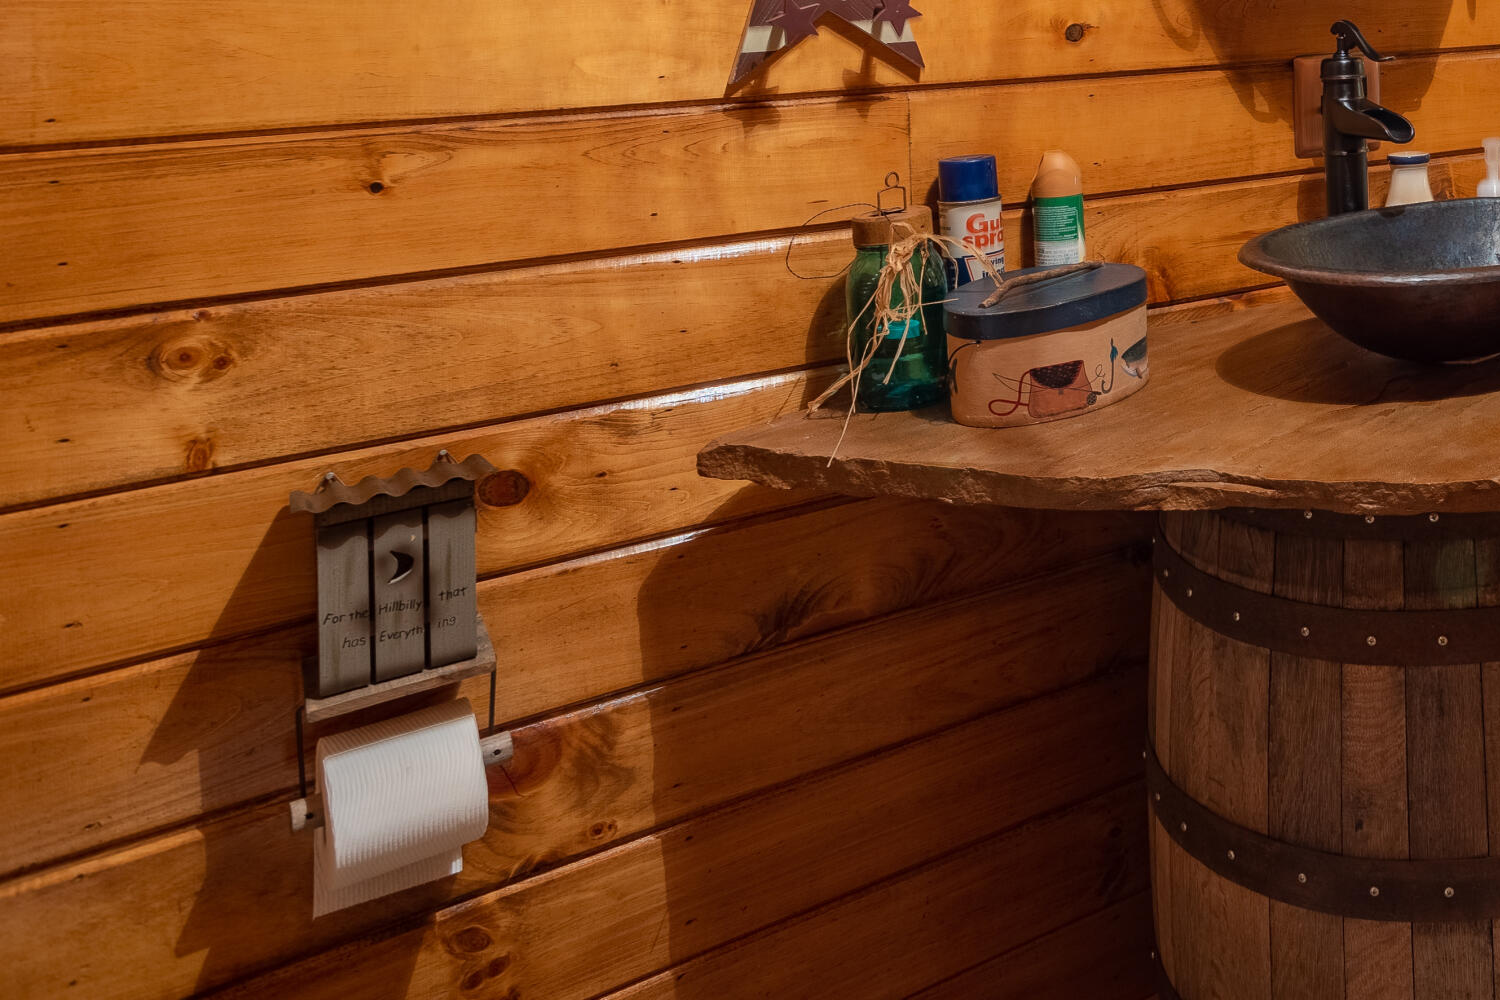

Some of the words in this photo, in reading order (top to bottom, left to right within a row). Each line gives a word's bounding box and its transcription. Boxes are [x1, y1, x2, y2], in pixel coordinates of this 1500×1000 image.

[323, 613, 346, 625] For
[349, 610, 369, 621] the
[378, 600, 423, 615] Hillbilly
[438, 587, 468, 601] that
[342, 636, 366, 649] has
